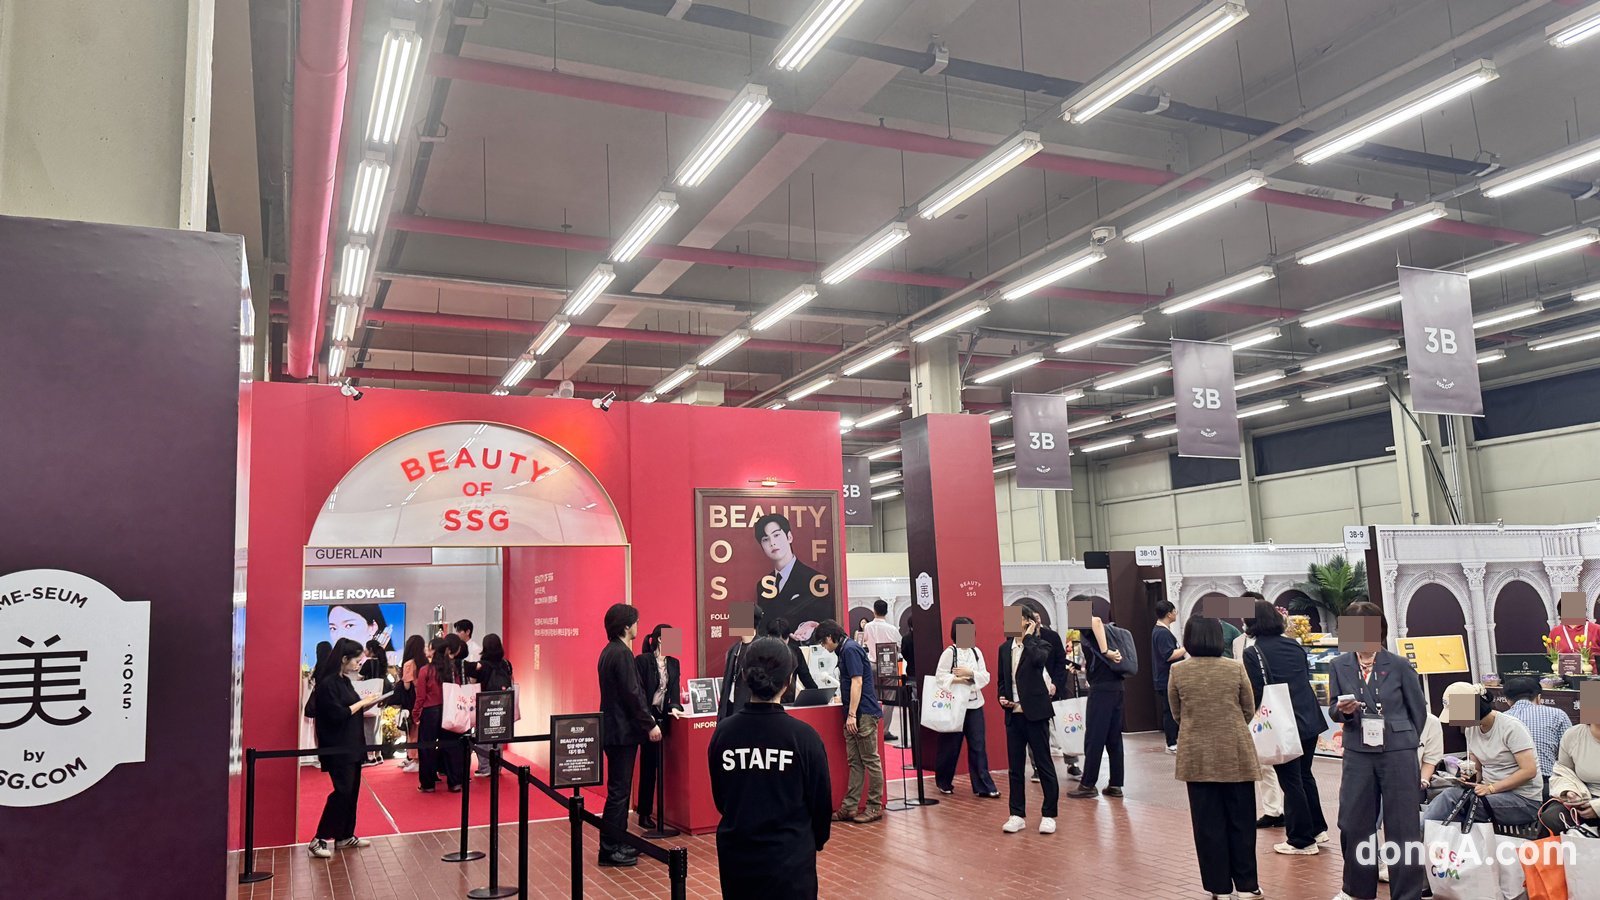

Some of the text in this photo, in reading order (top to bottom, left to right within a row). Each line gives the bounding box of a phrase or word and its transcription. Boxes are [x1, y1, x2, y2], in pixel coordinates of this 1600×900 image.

[1423, 326, 1458, 354] 3B
[1191, 387, 1221, 409] 3B
[1029, 432, 1055, 450] 3B
[400, 447, 550, 483] BEAUTY
[462, 482, 493, 496] OF
[842, 484, 861, 498] 3B
[444, 509, 509, 532] SSG
[315, 548, 383, 560] GUERLAIN
[346, 588, 396, 599] ROYALE
[23, 749, 45, 763] by
[722, 748, 794, 772] STAFF
